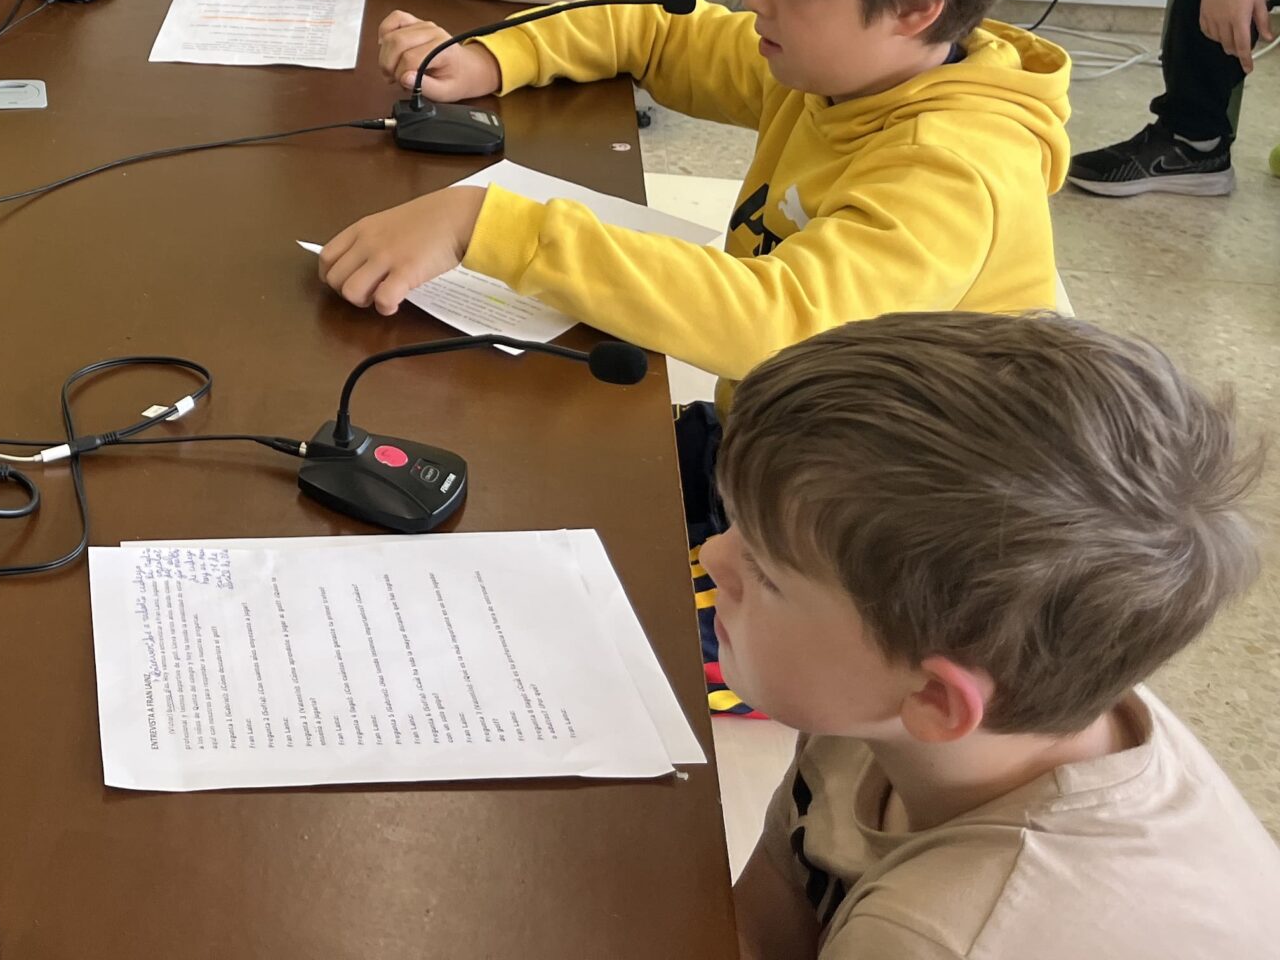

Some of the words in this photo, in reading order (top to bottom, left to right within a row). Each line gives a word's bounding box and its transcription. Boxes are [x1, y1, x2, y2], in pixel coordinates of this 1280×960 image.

[143, 672, 152, 689] LAINZ
[145, 690, 154, 707] FRAN
[147, 712, 158, 750] ENTREVISTA
[227, 723, 237, 748] Pregunta
[264, 722, 274, 748] Pregunta
[302, 721, 312, 746] Pregunta
[353, 719, 364, 745] Pregunta
[390, 718, 401, 744] Pregunta
[427, 717, 439, 743] Pregunta
